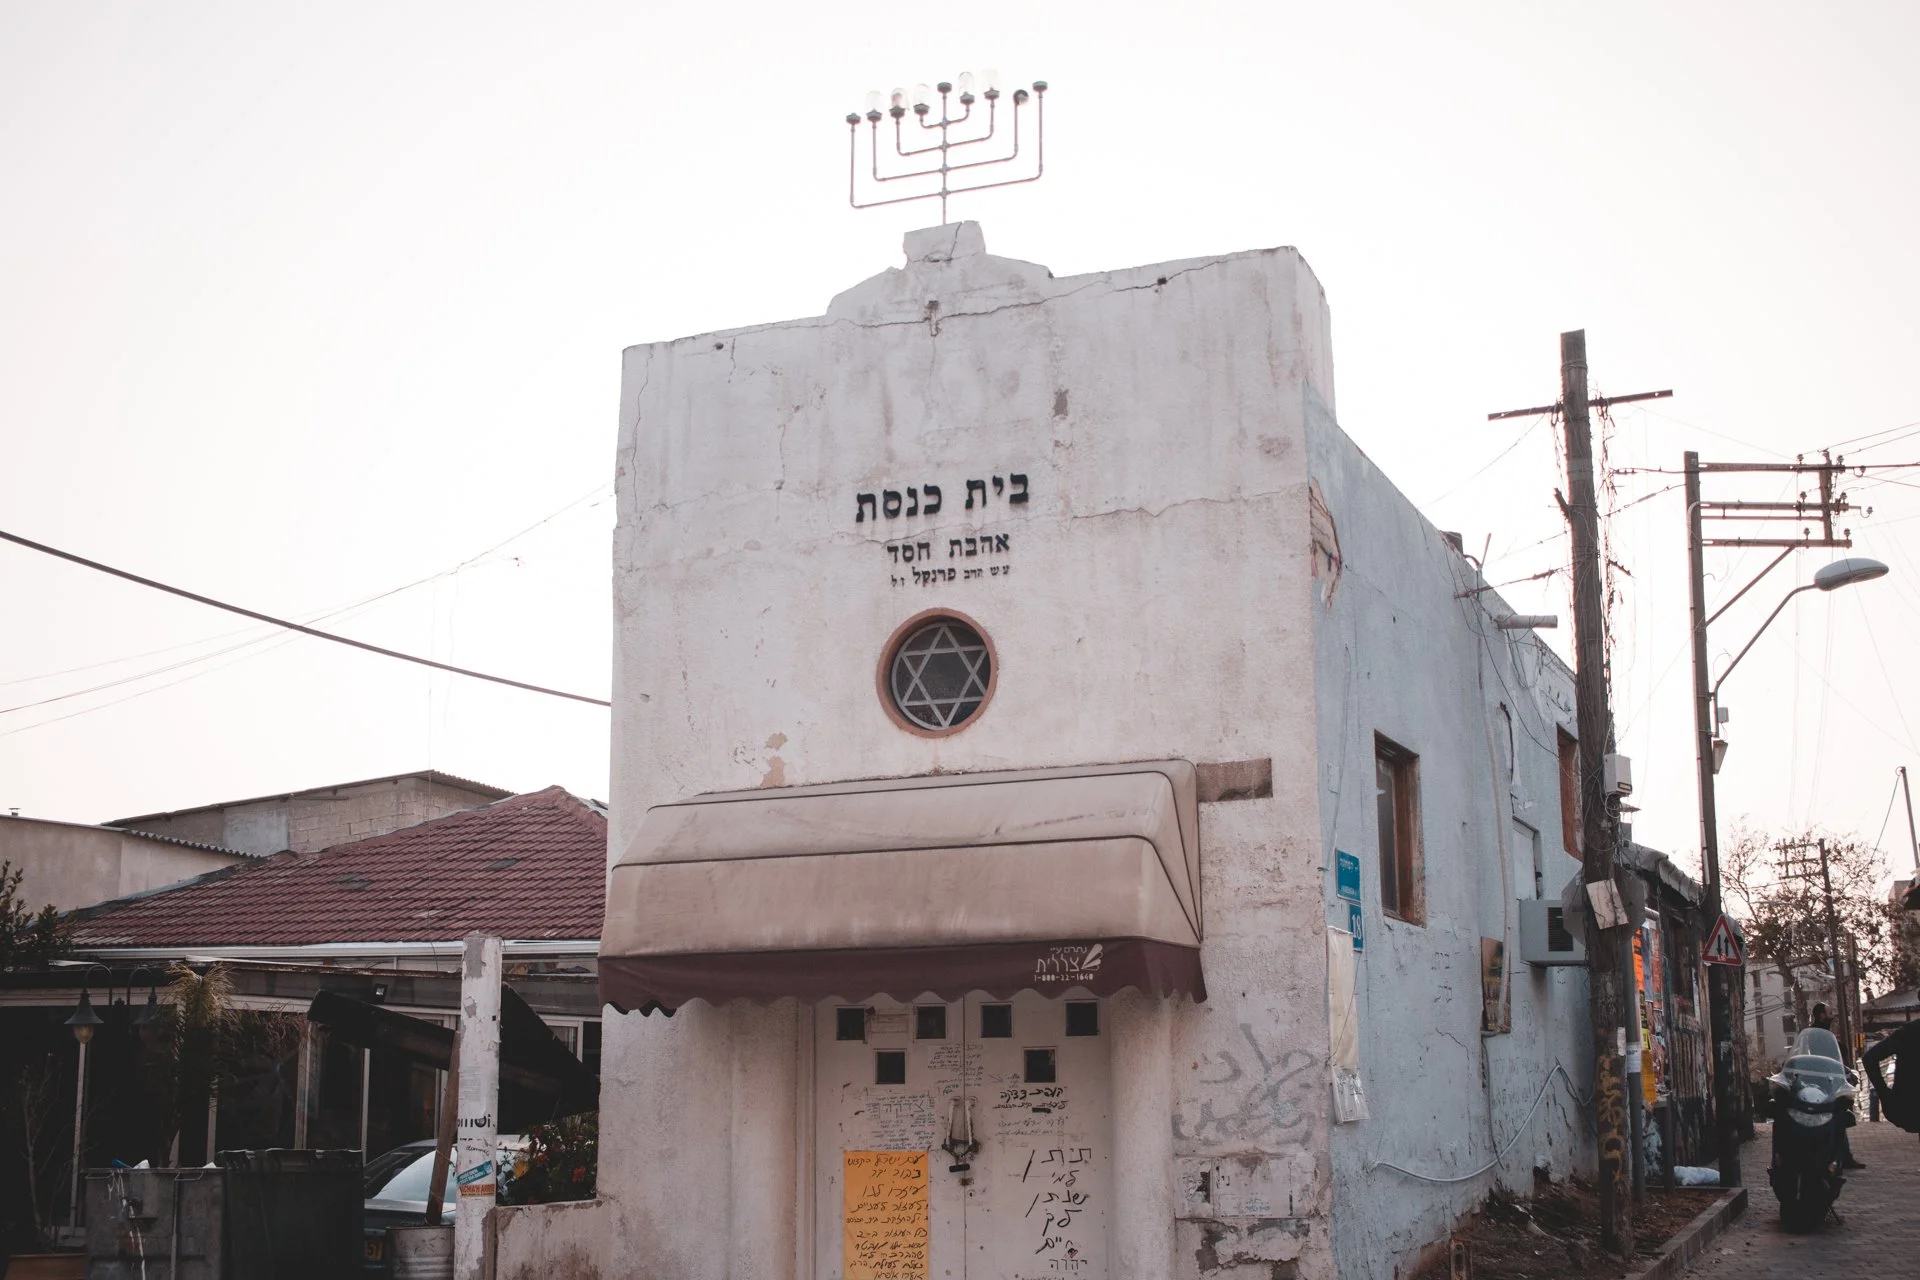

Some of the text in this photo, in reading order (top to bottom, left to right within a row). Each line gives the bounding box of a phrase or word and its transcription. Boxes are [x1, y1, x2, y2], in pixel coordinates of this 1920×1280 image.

[856, 473, 1029, 523] בית כנסת
[887, 533, 1010, 563] אהבת חסד
[912, 566, 956, 587] פרנקל
[963, 568, 983, 580] הרב
[1352, 914, 1362, 939] 18
[1035, 953, 1080, 973] צללית
